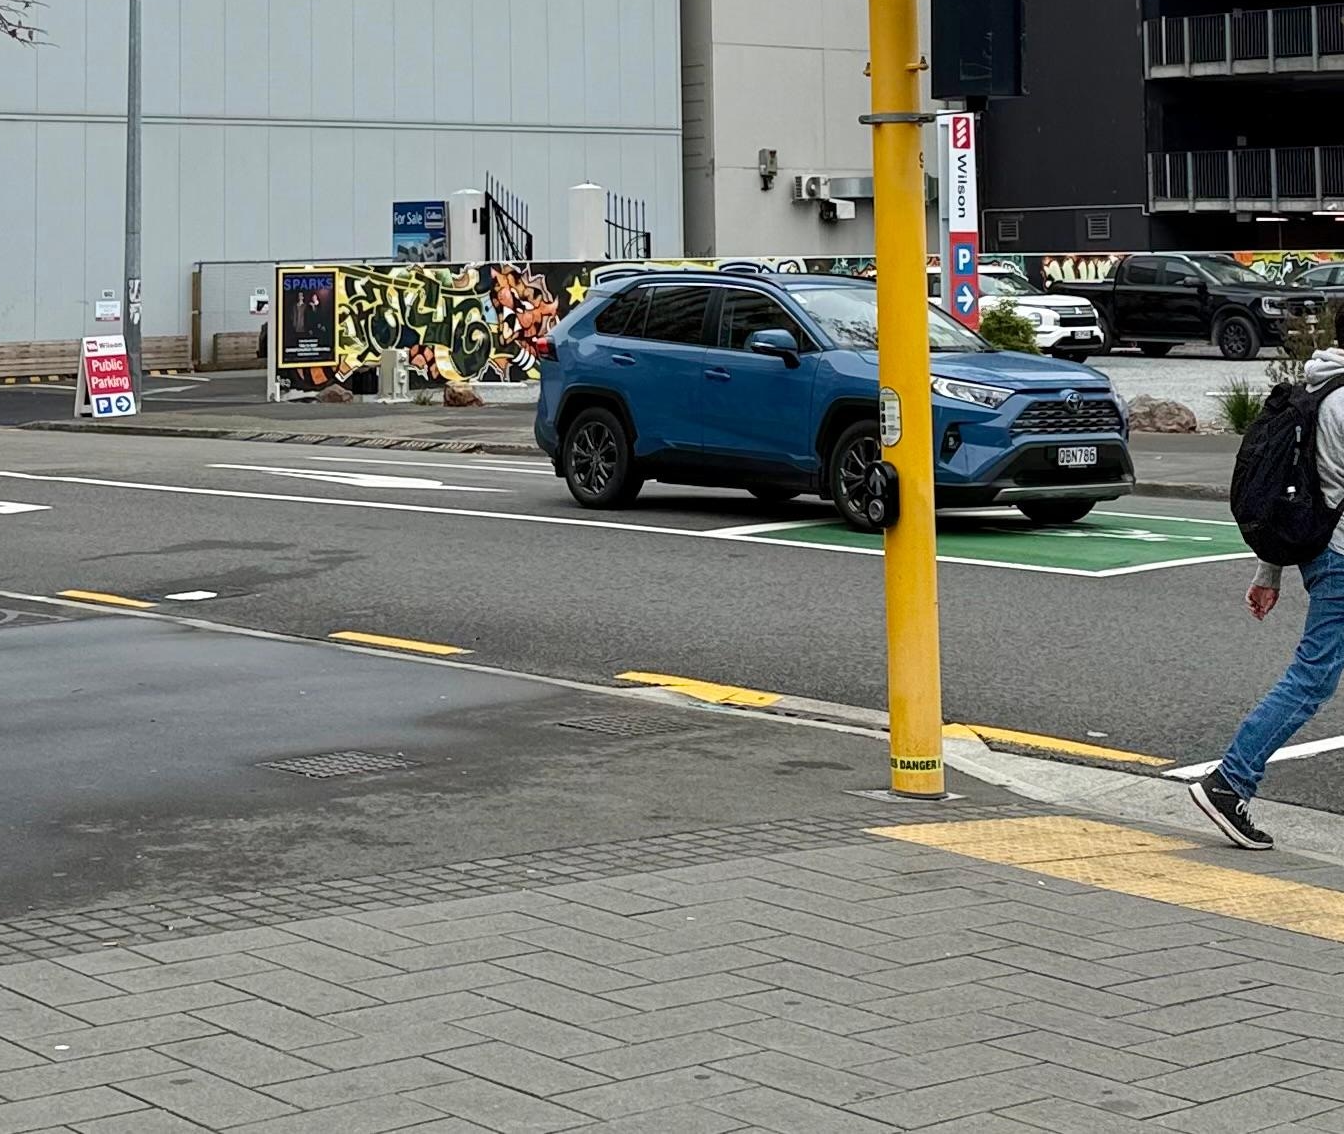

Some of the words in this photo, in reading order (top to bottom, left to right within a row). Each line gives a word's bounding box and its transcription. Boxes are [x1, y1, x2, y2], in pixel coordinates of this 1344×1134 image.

[957, 154, 968, 218] Wilson
[394, 211, 405, 225] For
[407, 211, 423, 225] Sale
[959, 248, 971, 271] P
[283, 277, 333, 291] SPARKS
[91, 359, 123, 372] Public
[91, 375, 130, 390] Parking
[98, 400, 109, 412] P
[1059, 448, 1096, 464] QBN786
[899, 759, 937, 771] DANGER
